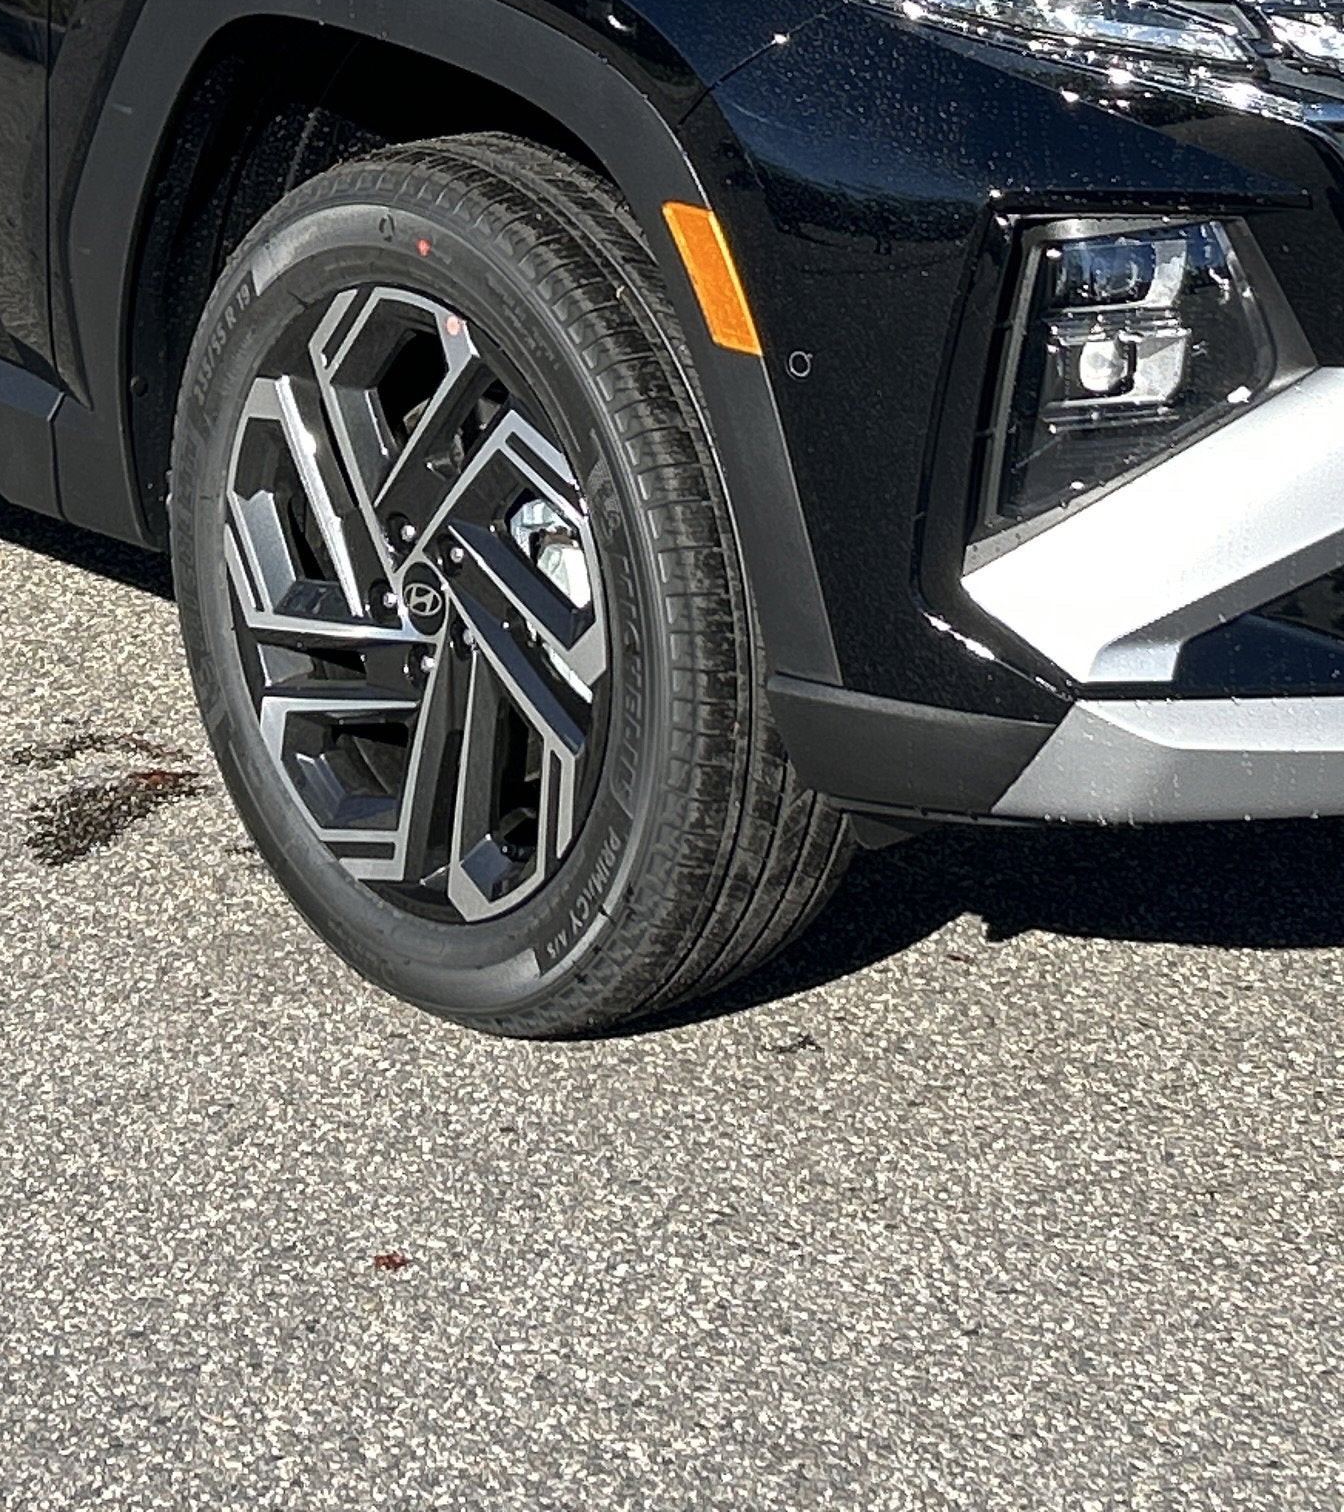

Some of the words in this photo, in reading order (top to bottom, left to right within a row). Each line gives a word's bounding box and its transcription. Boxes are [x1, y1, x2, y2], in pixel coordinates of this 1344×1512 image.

[224, 305, 238, 330] R
[235, 283, 252, 311] 19
[569, 825, 622, 936] PRIMACY
